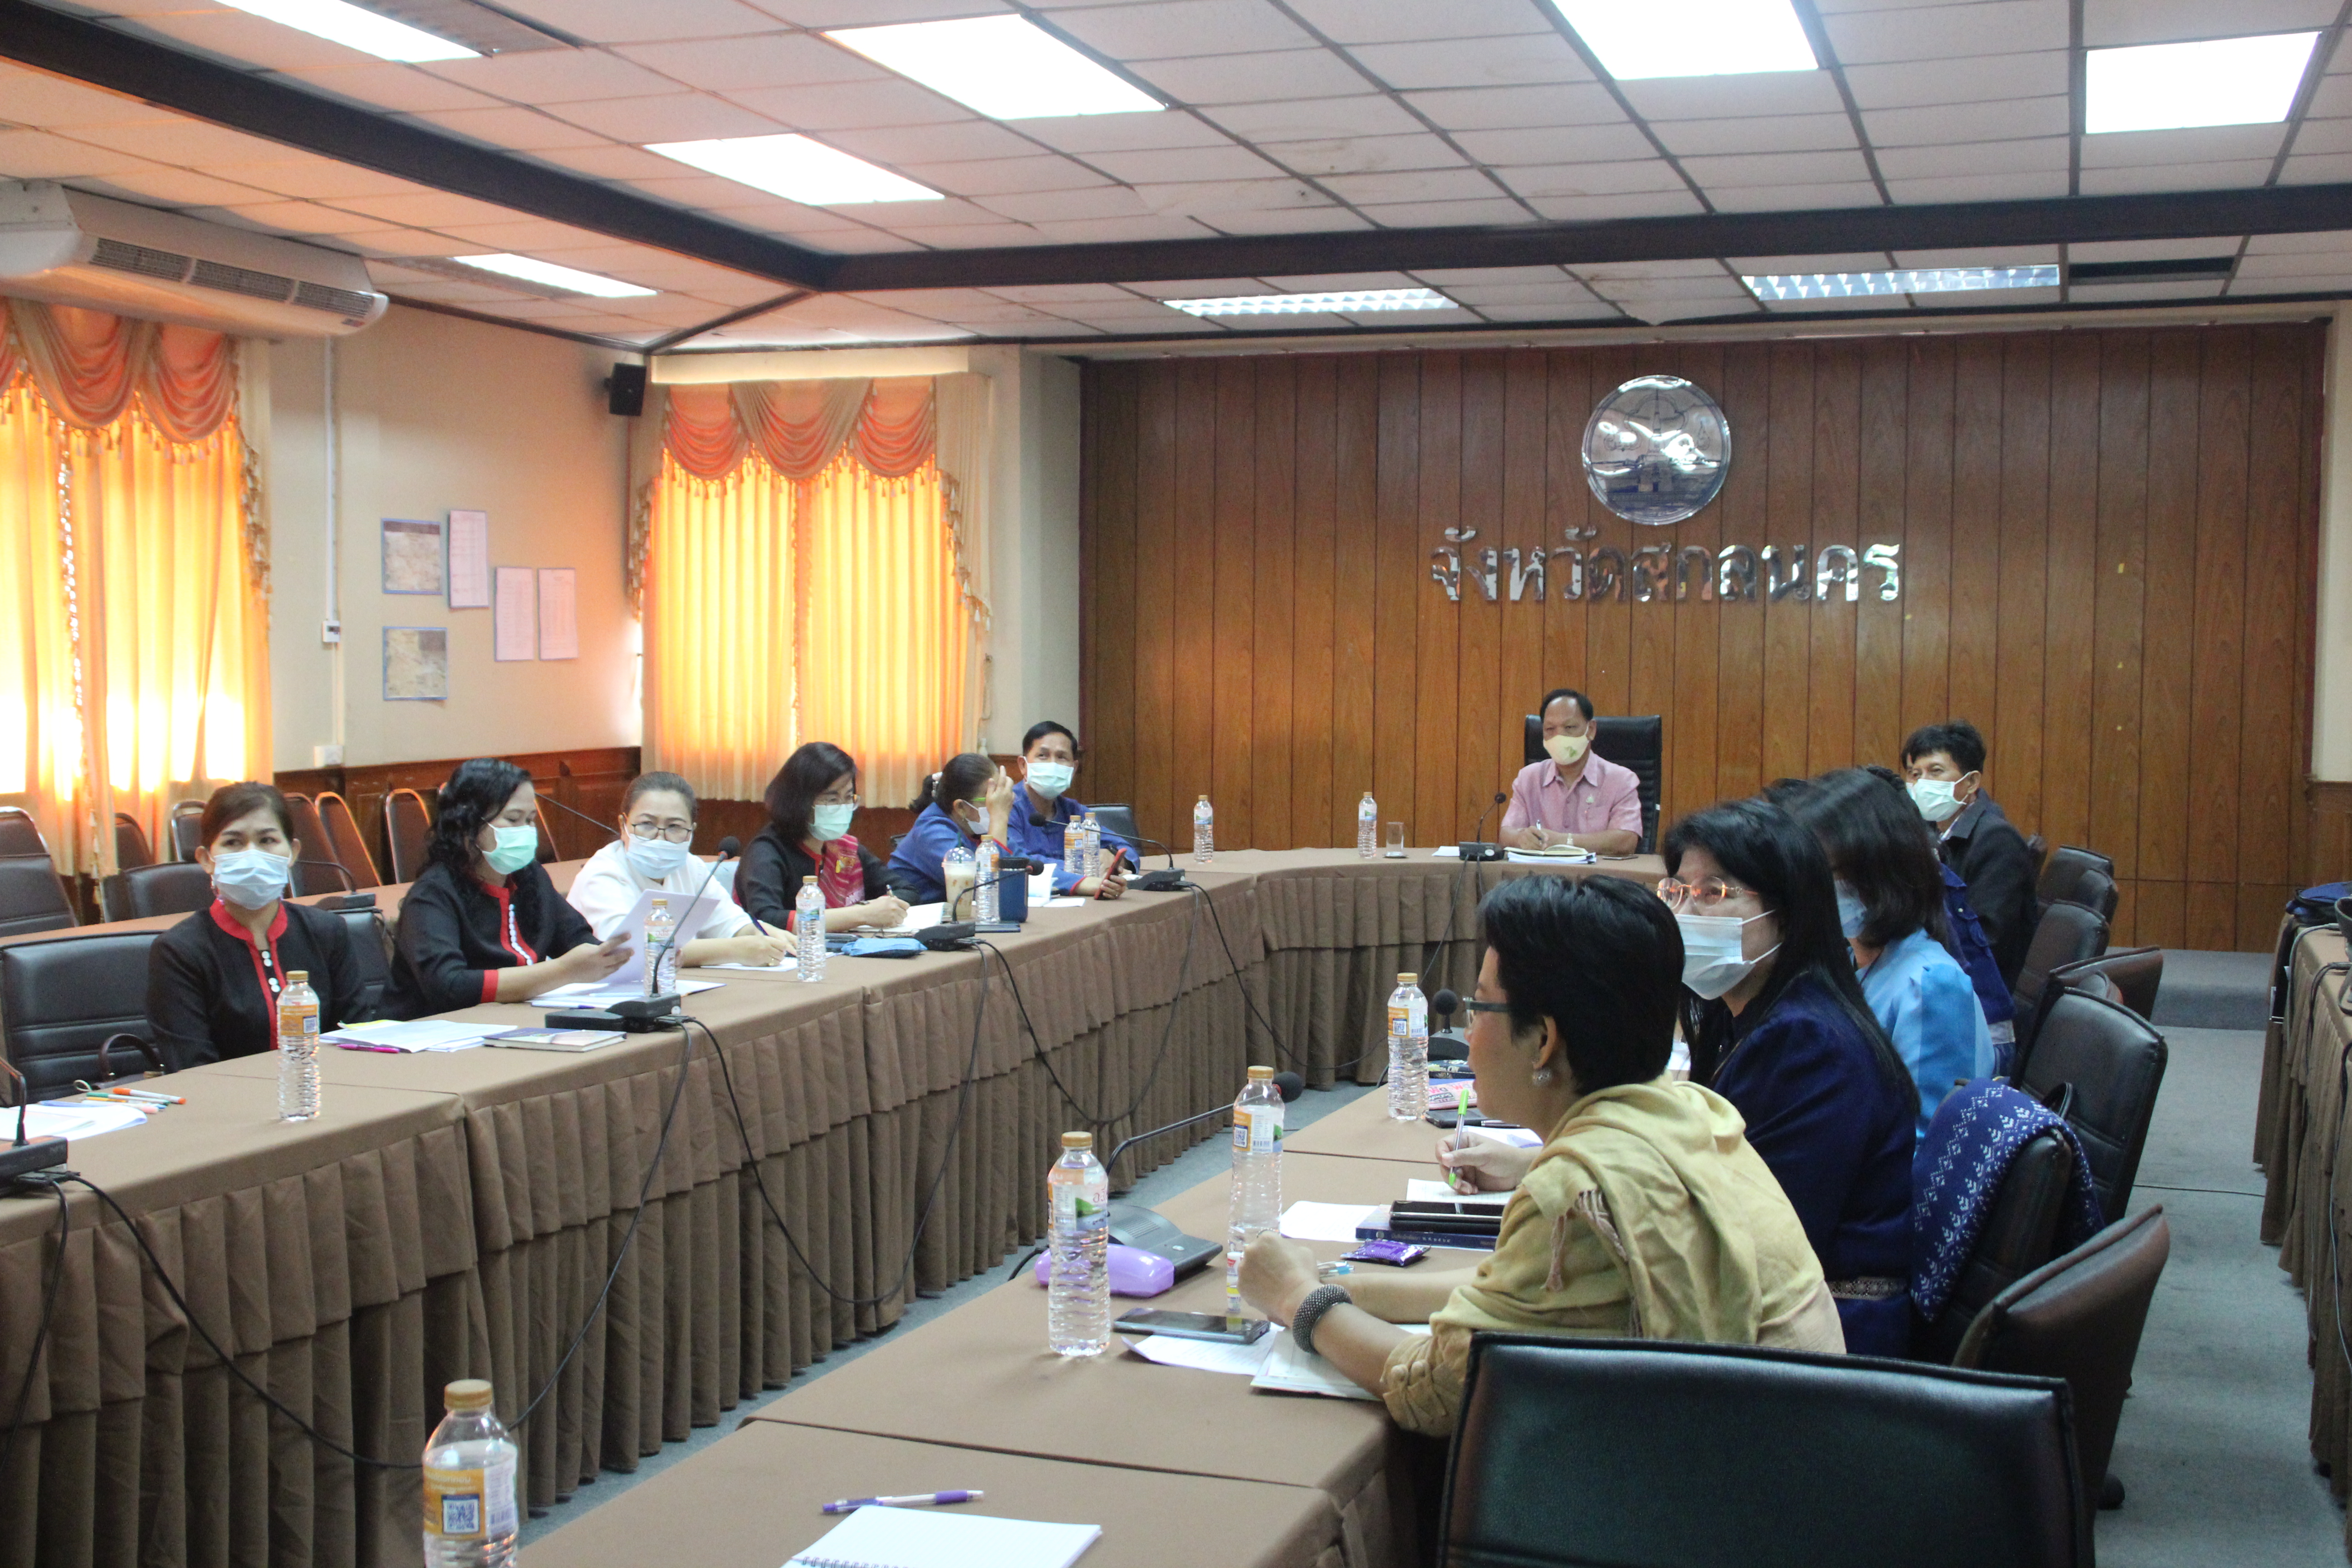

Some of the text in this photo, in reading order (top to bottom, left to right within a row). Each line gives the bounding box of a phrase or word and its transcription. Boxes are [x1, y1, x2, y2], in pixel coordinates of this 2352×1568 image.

[1430, 525, 1900, 603] จังหวัดสกลนคร
